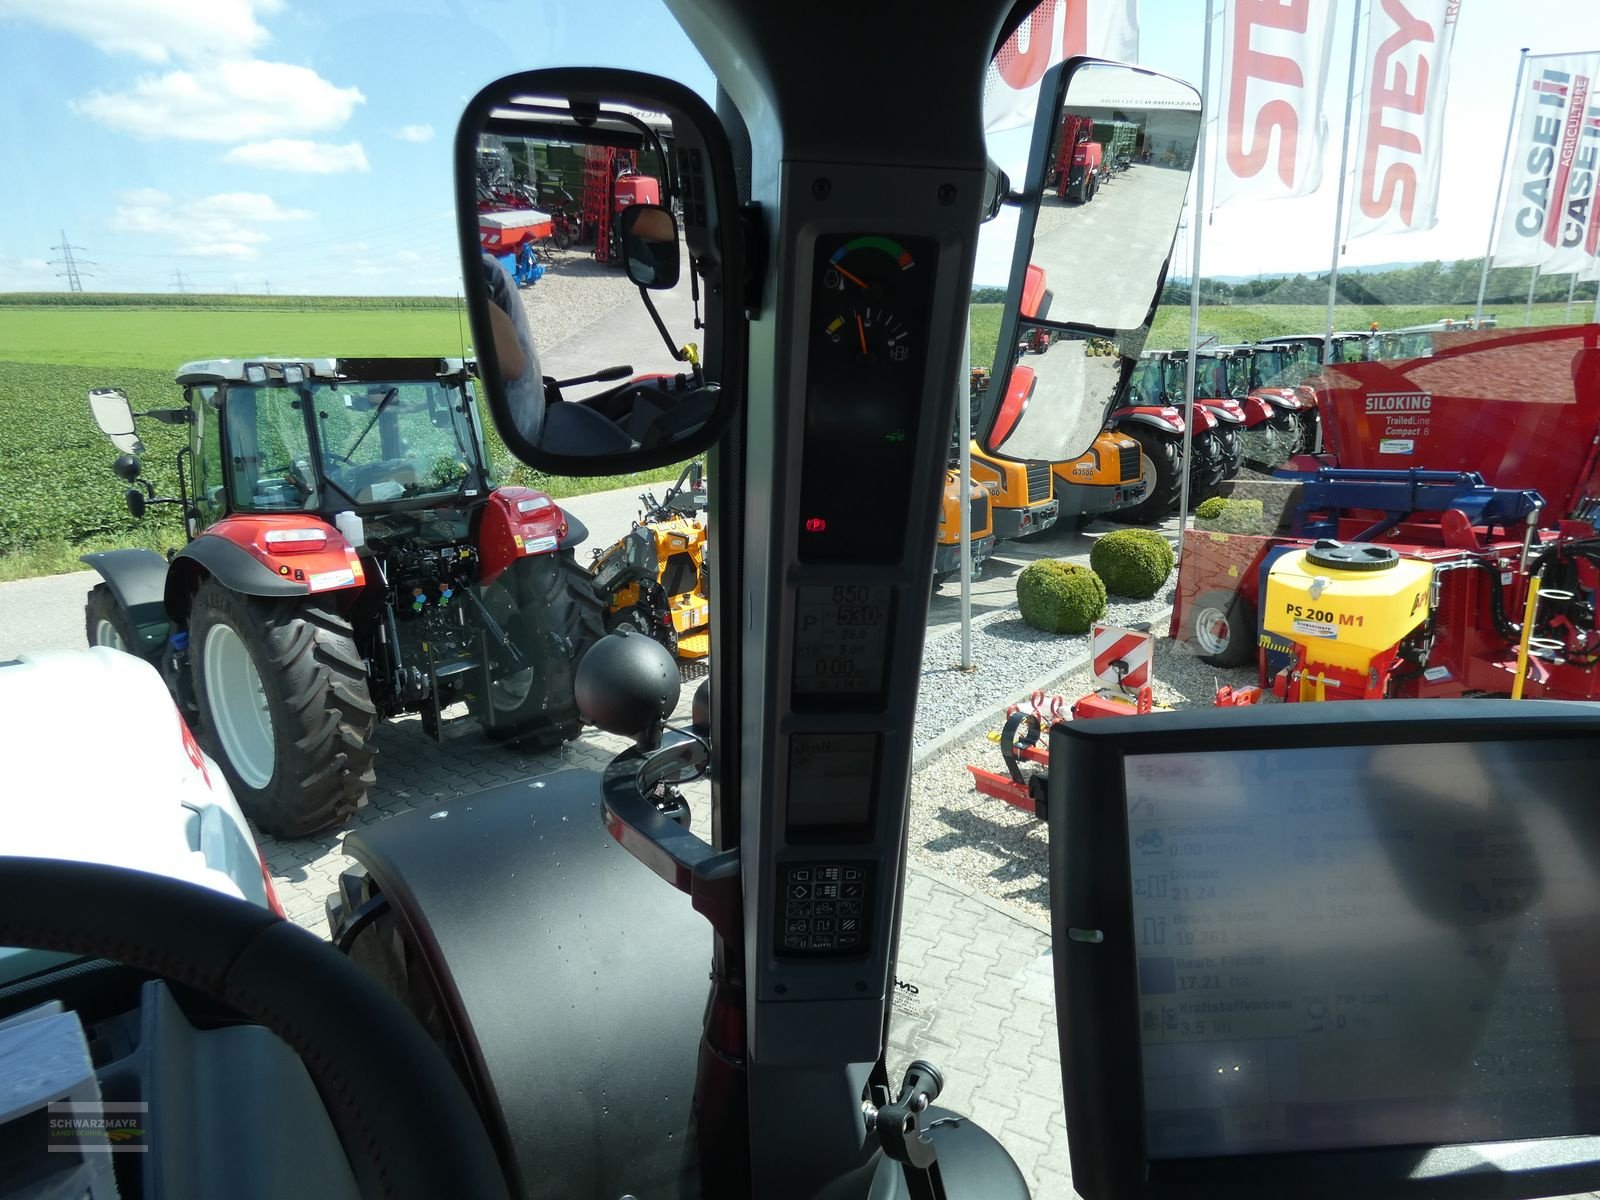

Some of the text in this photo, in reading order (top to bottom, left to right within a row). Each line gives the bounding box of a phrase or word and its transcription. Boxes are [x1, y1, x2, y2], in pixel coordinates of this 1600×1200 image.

[1561, 79, 1587, 168] AGRICULTURE
[1515, 115, 1562, 238] CASE
[1562, 146, 1598, 248] CASE
[1365, 396, 1431, 410] SILOKING
[1386, 415, 1430, 425] TrailedLine
[1385, 427, 1420, 437] Compact
[832, 585, 869, 603] 850
[1286, 603, 1364, 627] PS 200 M1
[1178, 975, 1220, 990] 17.21
